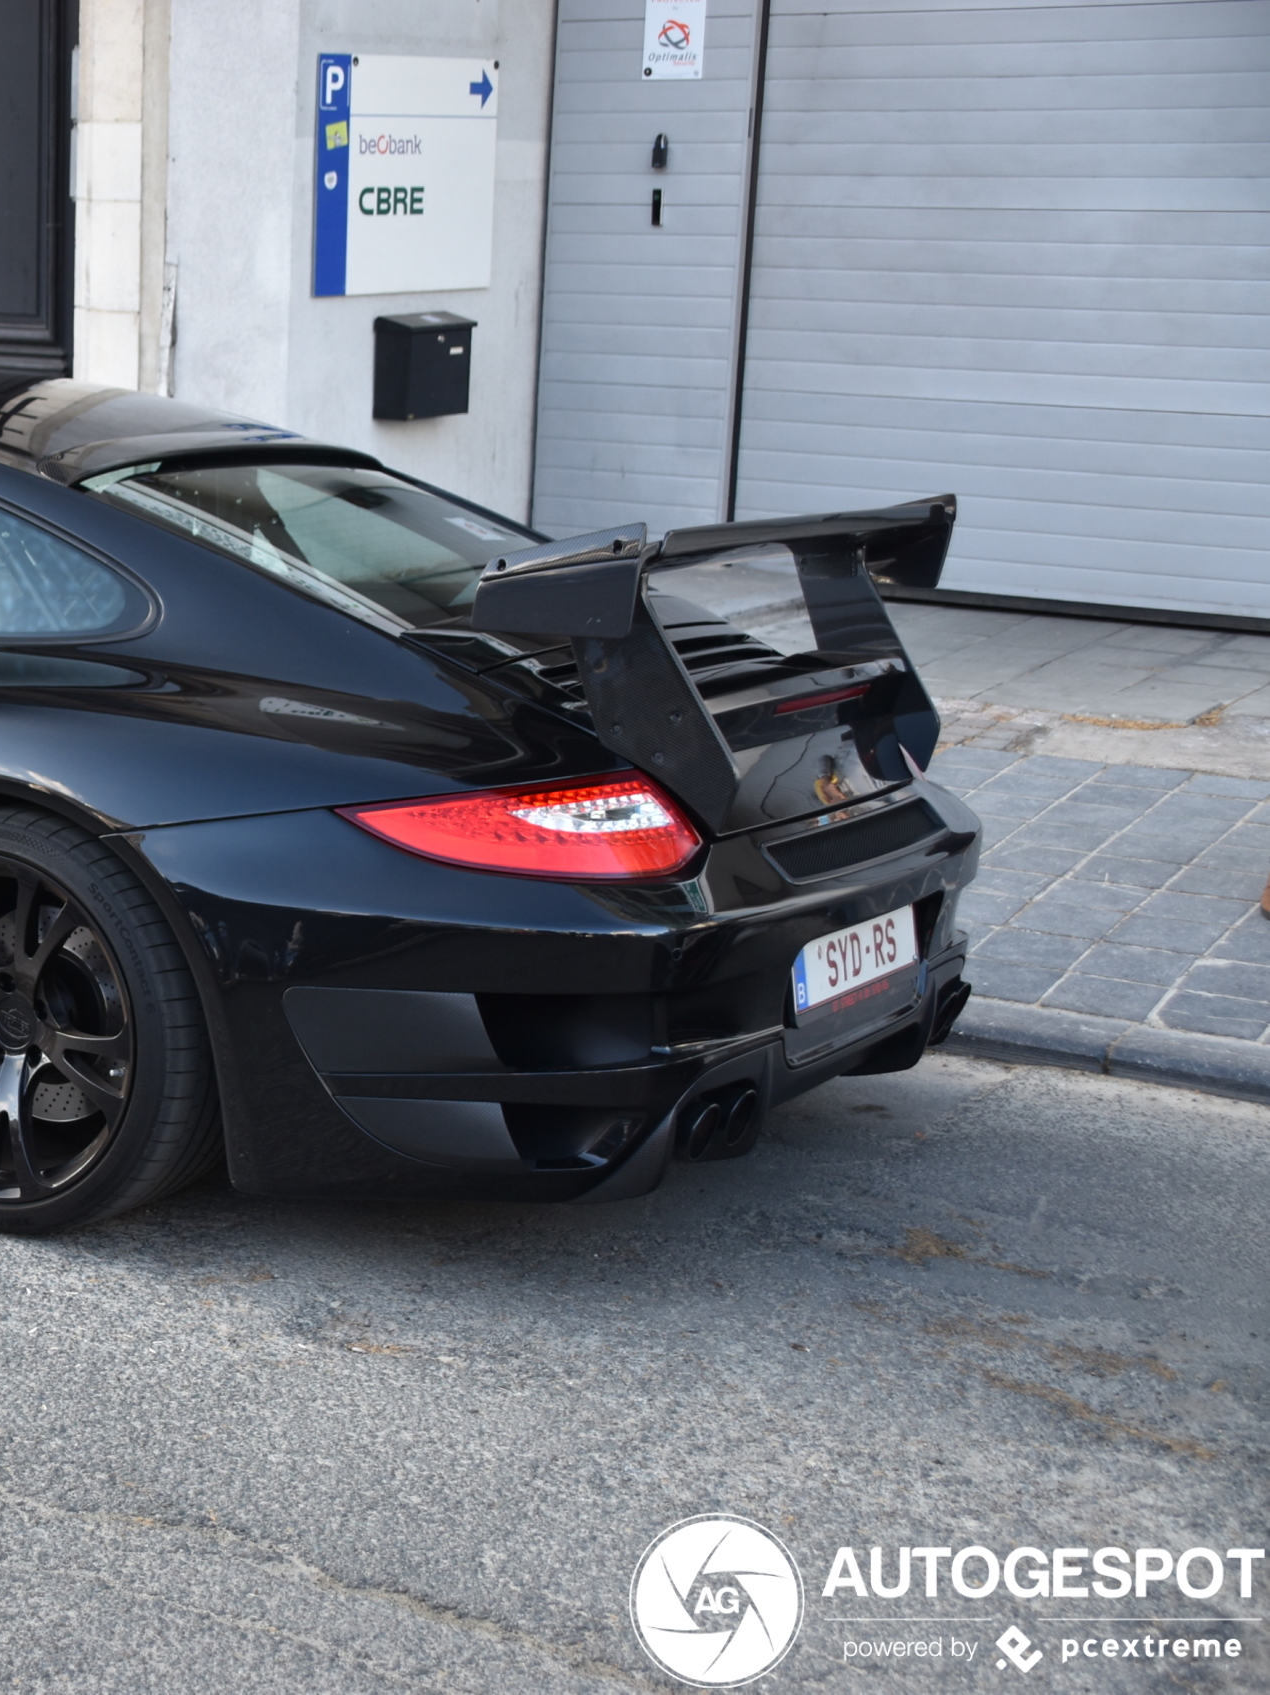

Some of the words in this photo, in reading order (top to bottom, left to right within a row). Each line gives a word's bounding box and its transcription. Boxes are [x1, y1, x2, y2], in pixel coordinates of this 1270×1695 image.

[648, 52, 697, 64] Optimalis
[325, 65, 345, 105] P
[358, 186, 425, 216] CBRE
[87, 882, 152, 996] SportContact
[826, 918, 897, 988] SYD-RS
[797, 982, 806, 1004] B
